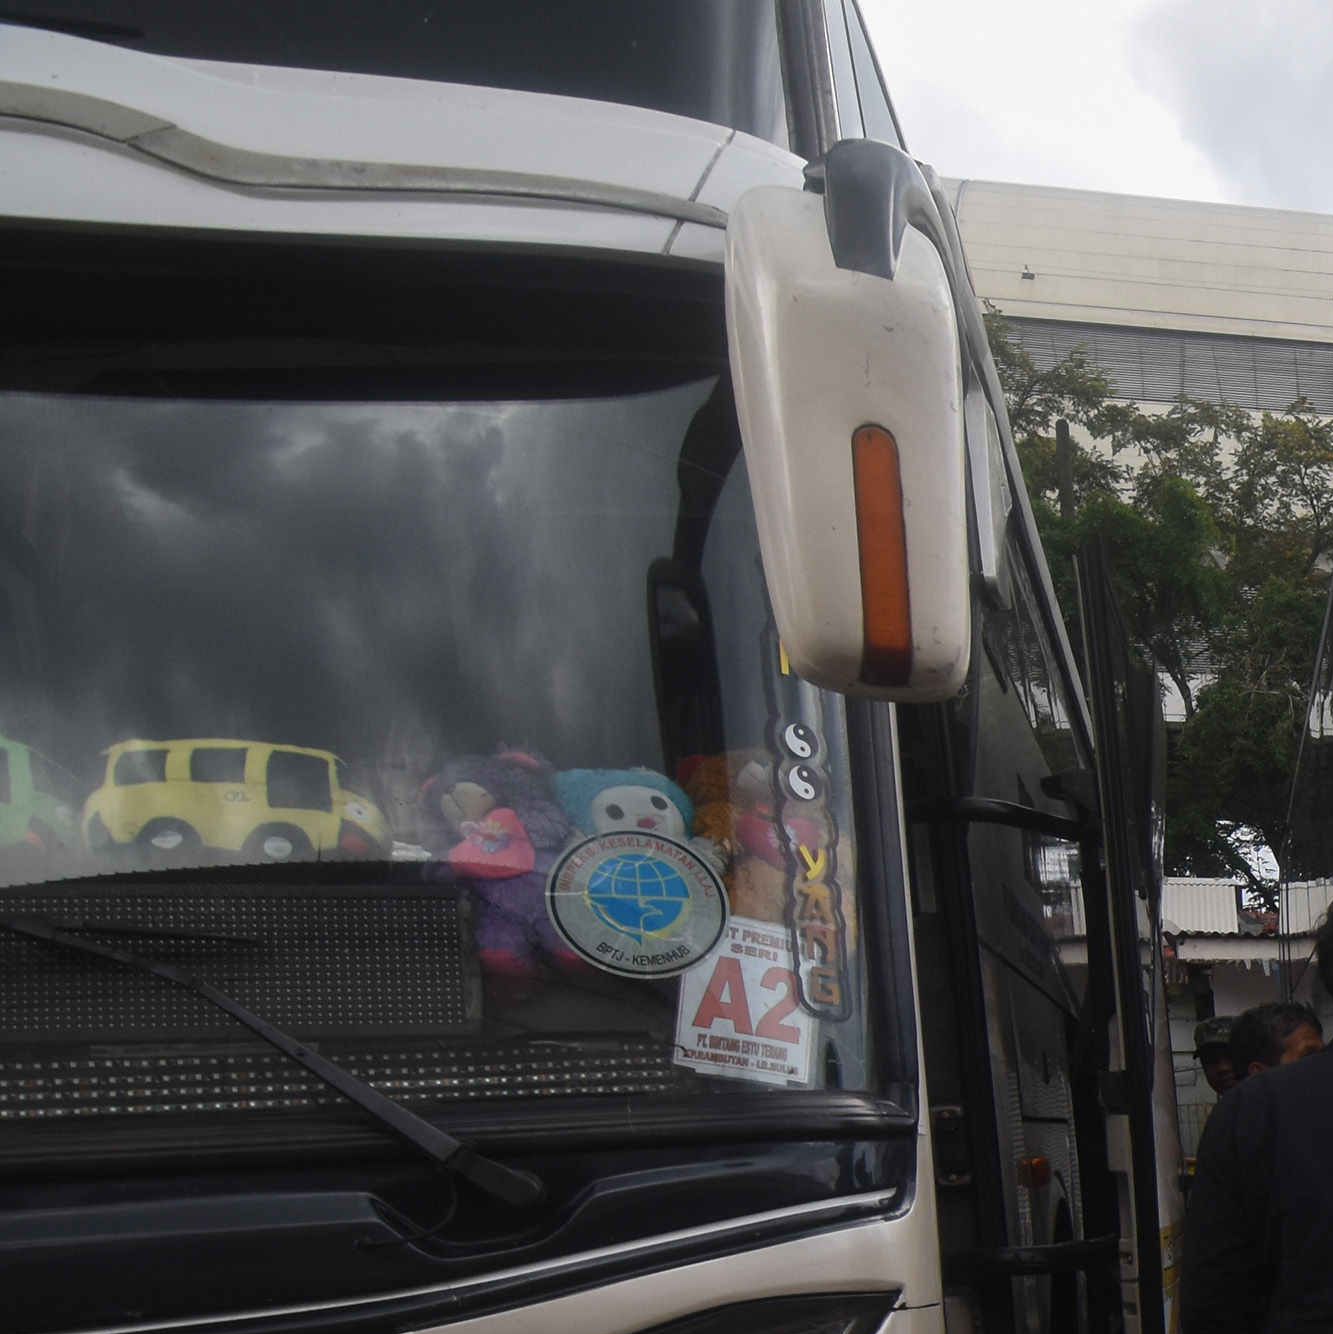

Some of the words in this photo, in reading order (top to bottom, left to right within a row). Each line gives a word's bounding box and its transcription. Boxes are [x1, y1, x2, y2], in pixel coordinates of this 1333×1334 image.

[600, 837, 695, 871] KESELAMATAN
[596, 941, 625, 961] BPTJ
[632, 944, 690, 967] KEMENHUB
[730, 943, 778, 962] SERI
[692, 955, 800, 1044] A2
